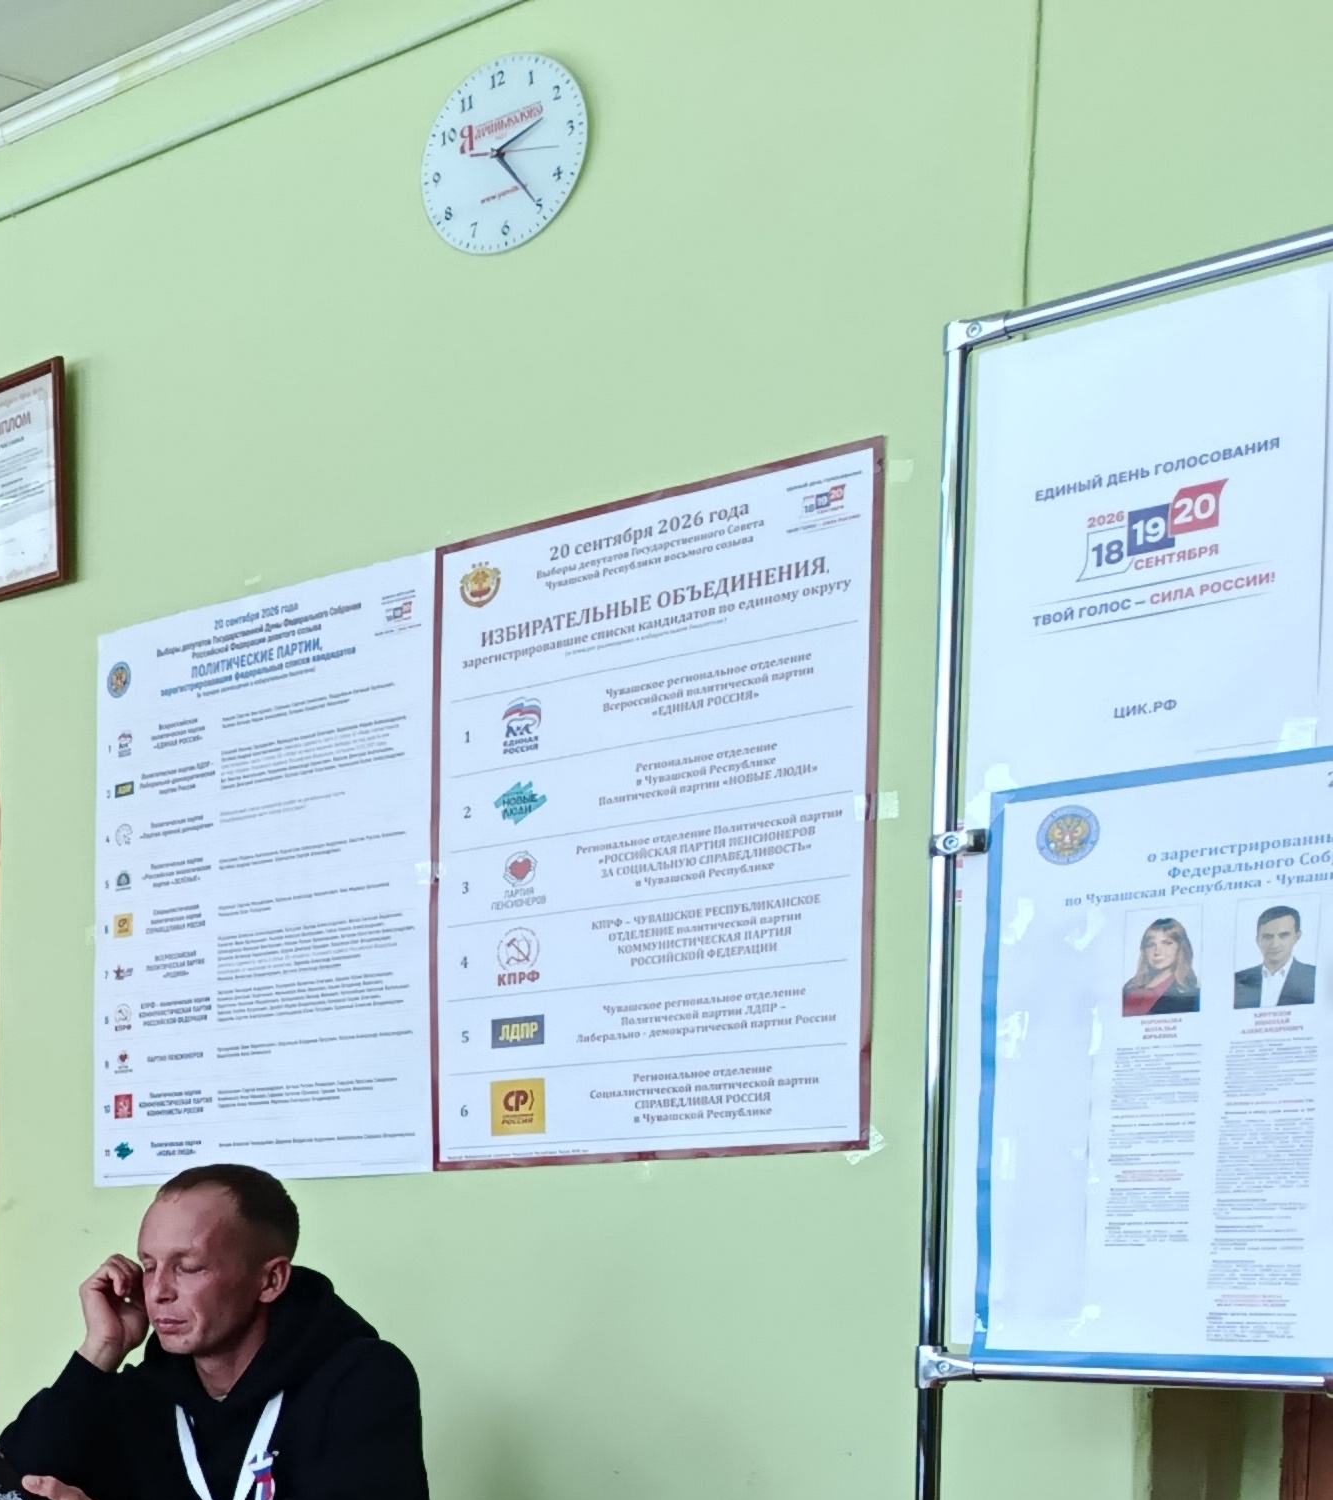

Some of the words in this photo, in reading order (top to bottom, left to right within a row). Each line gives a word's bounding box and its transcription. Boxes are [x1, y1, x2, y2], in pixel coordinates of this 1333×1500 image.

[490, 70, 505, 89] 12
[528, 70, 534, 85] 1
[460, 95, 473, 113] 11
[553, 85, 561, 101] 2
[441, 128, 456, 146] 10
[568, 120, 575, 135] 3
[433, 172, 441, 186] 9
[553, 166, 562, 181] 4
[444, 207, 453, 220] 8
[471, 222, 478, 238] 7
[501, 221, 510, 235] 6
[1035, 474, 1103, 503] ЕДИНЫЙ
[1106, 466, 1150, 489] ДЕНЬ
[1154, 437, 1280, 477] ГОЛОСОВАНИЯ
[1087, 511, 1125, 529] 2026
[1091, 540, 1124, 568] 18
[1132, 517, 1165, 546] 19
[1173, 492, 1216, 524] 20
[549, 543, 570, 561] 20
[574, 525, 653, 555] сентября
[657, 510, 703, 534] 2026
[708, 503, 749, 523] года
[536, 563, 577, 579] Выборы
[578, 551, 629, 571] депутатов
[631, 528, 725, 556] Государственного
[726, 519, 764, 534] Совета
[1133, 544, 1219, 571] СЕНТЯБРЯ
[544, 569, 600, 590] Чувашской
[602, 556, 661, 577] Республики
[663, 545, 713, 562] восьмого
[715, 535, 753, 550] созыва
[481, 594, 651, 647] ИЗБИРАТЕЛЬНЫЕ
[656, 555, 829, 608] ОБЪЕДИНЕНИЯ,
[1032, 605, 1074, 627] ТВОЙ
[1078, 598, 1131, 620] ГОЛОС
[1149, 586, 1194, 607] СИЛА
[1199, 572, 1275, 599] РОССИИ!
[462, 634, 588, 669] зарегистрировавшие
[590, 624, 635, 640] списки
[638, 606, 715, 631] кандидатов
[718, 603, 735, 614] по
[738, 589, 799, 610] единому
[802, 578, 851, 596] округу
[190, 647, 274, 678] ПОЛИТИЧЕСКИЕ
[276, 637, 323, 659] ПАРТИИ,
[605, 680, 665, 699] Чувашское
[666, 664, 748, 688] региональное
[749, 652, 812, 671] отделение
[602, 688, 683, 712] Всероссийской
[686, 672, 769, 697] политической
[771, 666, 814, 681] партии
[651, 698, 704, 716] «ЕДИНАЯ
[706, 689, 759, 707] РОССИЯ»
[1113, 698, 1177, 719] ЦИК.РФ
[464, 730, 470, 743] 1
[502, 735, 538, 747] ЕДИНАЯ
[502, 742, 538, 755] РОССИЯ
[635, 753, 714, 772] Региональное
[715, 742, 777, 759] отделение
[635, 778, 642, 786] в
[644, 766, 706, 786] Чувашской
[709, 757, 776, 774] Республике
[598, 785, 677, 806] Политической
[679, 780, 720, 794] партии
[722, 769, 772, 785] «НОВЫЕ
[773, 763, 817, 778] ЛЮДИ»
[502, 793, 538, 806] НОВЫЕ
[463, 805, 471, 819] 2
[501, 804, 532, 819] ЛЮДИ
[575, 837, 650, 855] Региональное
[652, 828, 711, 843] отделение
[713, 813, 797, 835] Политической
[799, 809, 843, 823] партии
[598, 845, 677, 864] «РОССИЙСКАЯ
[679, 838, 726, 853] ПАРТИЯ
[728, 825, 815, 847] ПЕНСИОНЕРОВ
[600, 867, 614, 878] ЗА
[615, 856, 697, 875] СОЦИАЛЬНУЮ
[698, 841, 811, 865] СПРАВЕДЛИВОСТЬ»
[1147, 853, 1157, 863] о
[1168, 856, 1295, 880] Федерального
[1300, 850, 1333, 866] Соб
[634, 879, 641, 887] в
[643, 869, 705, 887] Чувашской
[708, 861, 774, 878] Республике
[461, 881, 469, 894] 3
[503, 886, 534, 898] ПАРТИЯ
[1065, 895, 1082, 907] по
[1086, 887, 1166, 906] Чувашская
[1171, 879, 1261, 896] Республика
[1276, 872, 1333, 886] Чуваш
[490, 894, 546, 910] ПЕНСИОНЕРОВ
[591, 917, 623, 930] КПРФ
[633, 908, 702, 925] ЧУВАШСКОЕ
[704, 893, 821, 916] РЕСПУБЛИКАНСКОЕ
[608, 925, 674, 942] ОТДЕЛЕНИЕ
[676, 915, 757, 934] политической
[759, 912, 801, 925] партии
[617, 931, 741, 954] КОММУНИСТИЧЕСКАЯ
[744, 925, 791, 941] ПАРТИЯ
[460, 955, 468, 968] 4
[630, 947, 704, 967] РОССИЙСКОЙ
[706, 941, 777, 958] ФЕДЕРАЦИИ
[497, 969, 540, 986] КПРФ
[602, 1001, 662, 1016] Чувашское
[664, 993, 742, 1010] региональное
[744, 987, 806, 1001] отделение
[620, 1009, 699, 1026] Политической
[701, 1007, 742, 1019] партии
[744, 1002, 777, 1015] ЛДПР
[461, 1030, 469, 1043] 5
[498, 1021, 538, 1043] ЛДПР
[575, 1031, 640, 1043] Либерально
[648, 1019, 747, 1038] демократической
[750, 1017, 792, 1030] партии
[795, 1013, 836, 1024] России
[632, 1069, 710, 1082] Региональное
[712, 1065, 772, 1077] отделение
[589, 1083, 692, 1099] Социалистической
[694, 1077, 775, 1092] политической
[777, 1076, 819, 1088] партии
[460, 1104, 468, 1117] 6
[634, 1094, 723, 1109] СПРАВЕДЛИВАЯ
[725, 1091, 770, 1104] РОССИЯ
[633, 1115, 640, 1123] в
[642, 1110, 704, 1124] Чувашской
[706, 1107, 772, 1120] Республике
